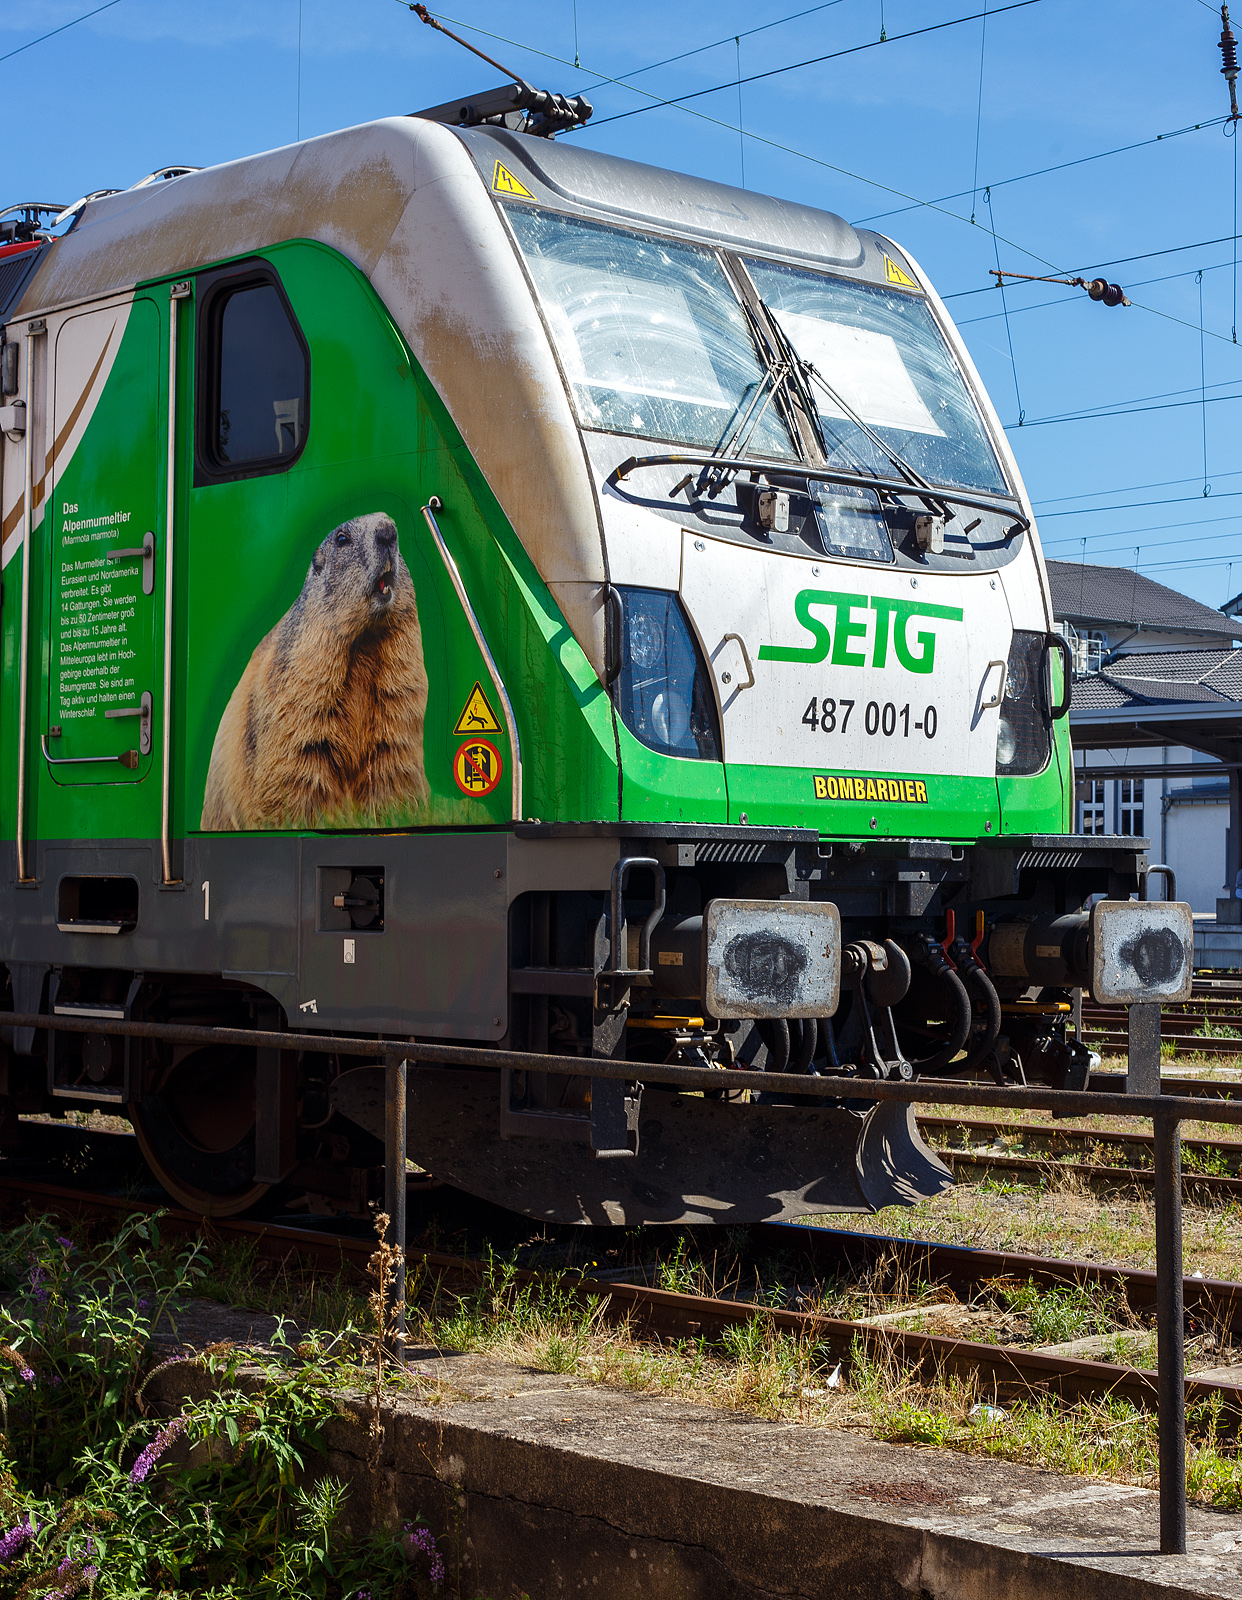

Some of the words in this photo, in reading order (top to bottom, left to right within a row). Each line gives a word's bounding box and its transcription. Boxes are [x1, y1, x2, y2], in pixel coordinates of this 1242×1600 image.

[63, 503, 78, 514] Das
[62, 511, 131, 533] Alpenmurmeltier
[62, 534, 89, 547] (Marmota
[91, 528, 119, 541] marmota)
[62, 563, 73, 572] Das
[75, 558, 105, 570] Murmeltier
[62, 575, 87, 585] Eurasien
[88, 572, 99, 581] und
[101, 567, 138, 580] Nordamerika
[61, 588, 89, 598] verbreitet.
[91, 585, 99, 594] Es
[100, 584, 111, 595] gibt
[62, 603, 68, 612] 14
[70, 600, 101, 611] Gattungen.
[103, 597, 112, 606] Sie
[114, 595, 136, 604] werden
[61, 616, 69, 625] bis
[79, 614, 86, 623] 50
[88, 611, 119, 622] Zentimeter
[121, 607, 134, 620] groß
[61, 629, 71, 639] und
[92, 626, 99, 635] 15
[100, 624, 117, 634] Jahre
[118, 623, 127, 632] alt.
[758, 589, 963, 674] SETG
[60, 643, 72, 652] Das
[73, 638, 120, 652] Alpenmurmeltier
[122, 637, 127, 645] in
[60, 655, 95, 666] Mitteleuropa
[97, 652, 108, 661] lebt
[118, 649, 136, 659] Hoch-
[60, 669, 81, 681] gebirge
[83, 666, 108, 676] oberhalb
[110, 665, 120, 674] der
[60, 683, 97, 693] Baumgrenze.
[100, 679, 109, 688] Sie
[111, 678, 123, 687] sind
[60, 697, 70, 707] Tag
[72, 696, 84, 705] aktiv
[87, 694, 97, 703] und
[99, 693, 117, 702] halten
[60, 707, 96, 718] Winterschlaf.
[802, 697, 855, 733] 487
[865, 701, 937, 739] 001-0
[815, 777, 927, 801] BOMBARDIER
[202, 880, 209, 920] 1
